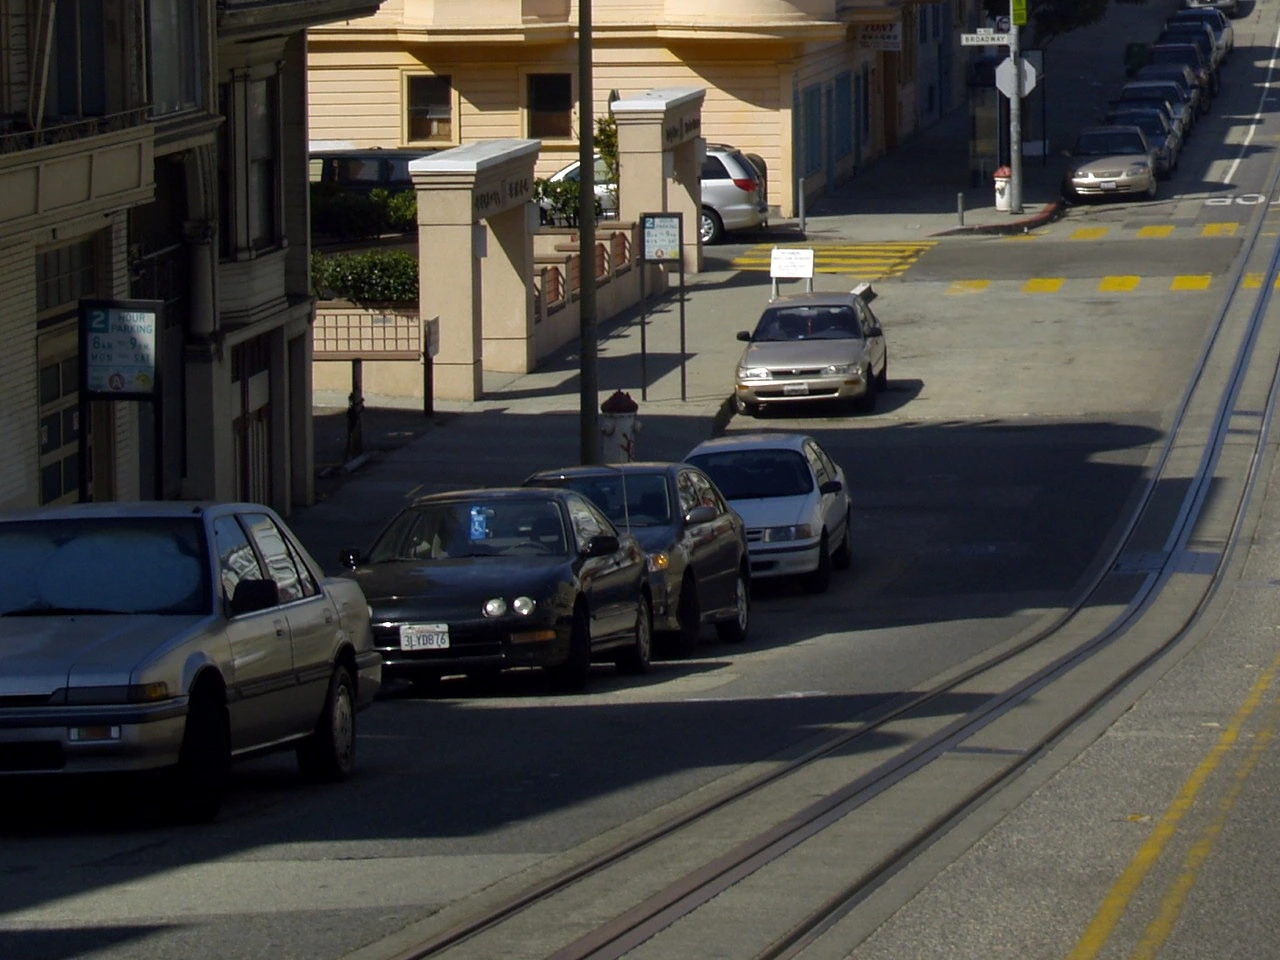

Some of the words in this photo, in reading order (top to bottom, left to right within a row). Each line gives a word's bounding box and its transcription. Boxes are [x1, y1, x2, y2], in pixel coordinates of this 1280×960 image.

[92, 311, 105, 328] 2
[118, 313, 146, 323] HOUR
[111, 324, 153, 334] PARKING
[404, 633, 447, 647] 3LYD876
